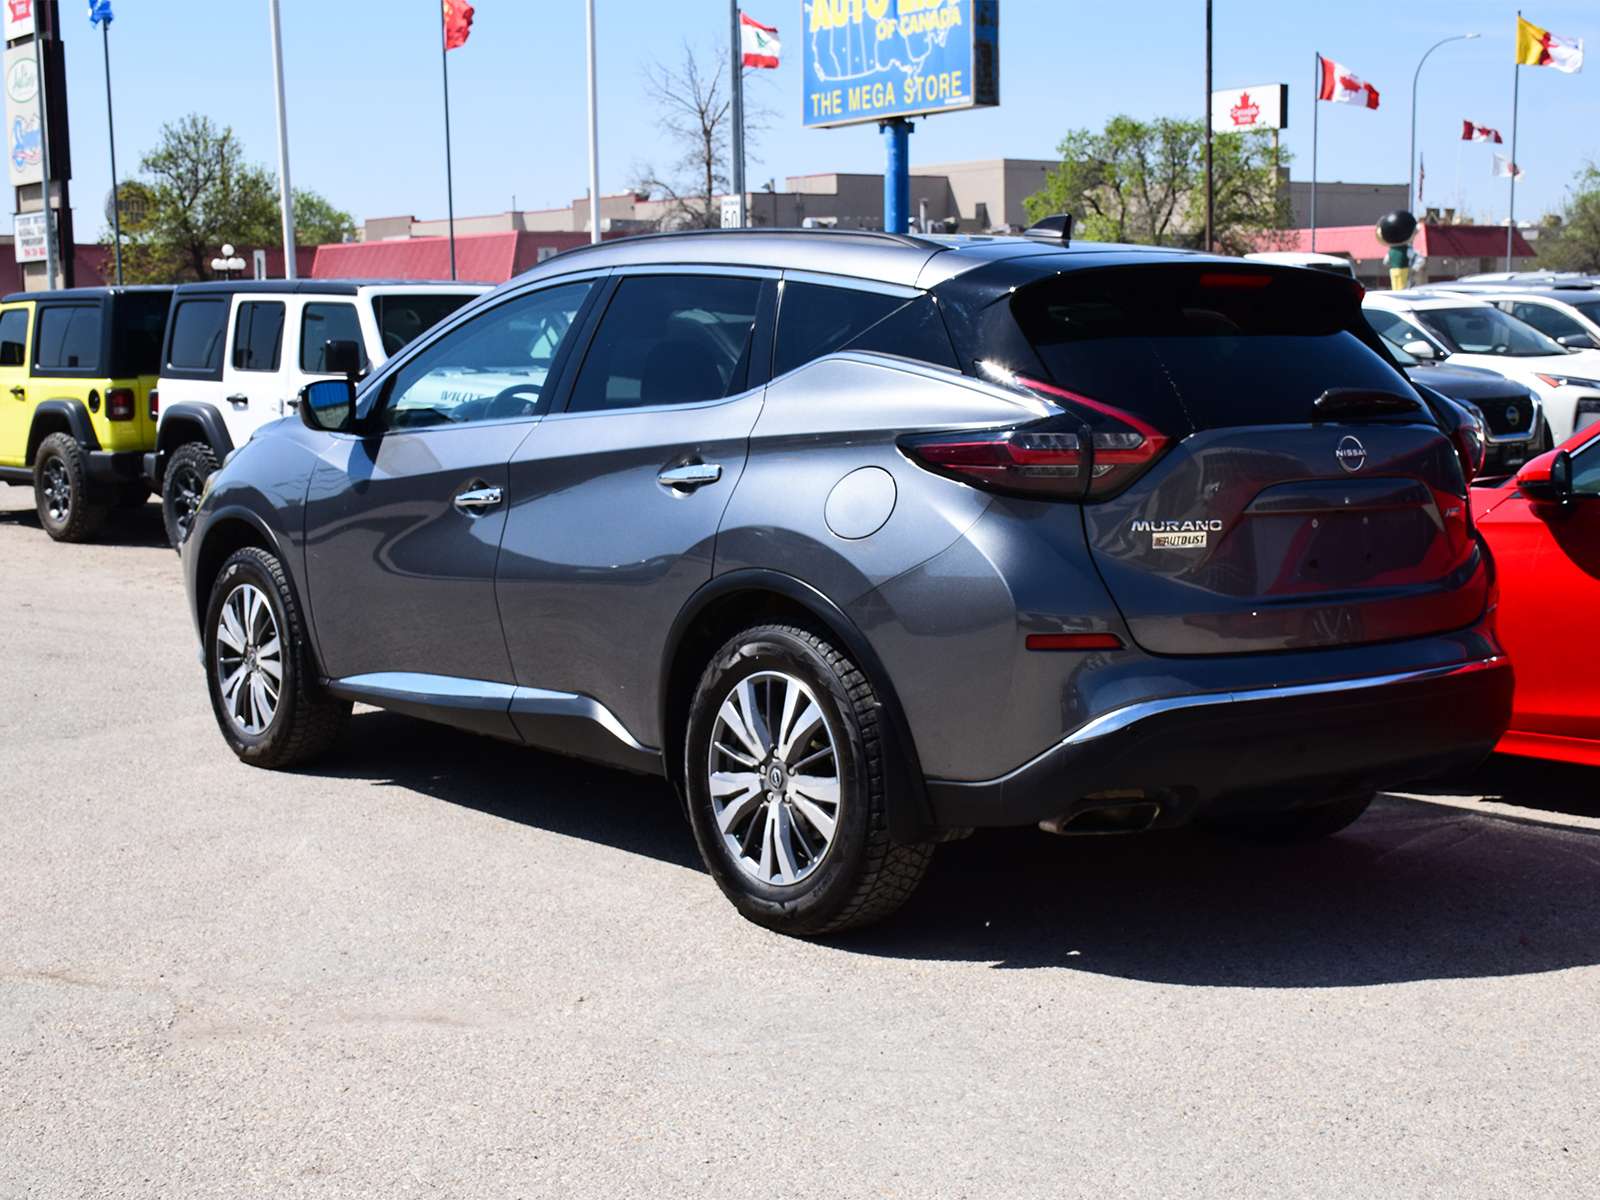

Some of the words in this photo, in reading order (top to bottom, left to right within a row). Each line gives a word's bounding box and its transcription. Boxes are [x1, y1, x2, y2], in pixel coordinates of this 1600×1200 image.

[876, 18, 896, 41] OF
[900, 6, 962, 37] CANADA
[811, 89, 842, 117] THE
[849, 81, 895, 112] MEGA
[904, 71, 962, 104] STORE
[1335, 449, 1367, 457] NISSAN
[1131, 519, 1223, 532] MURANO
